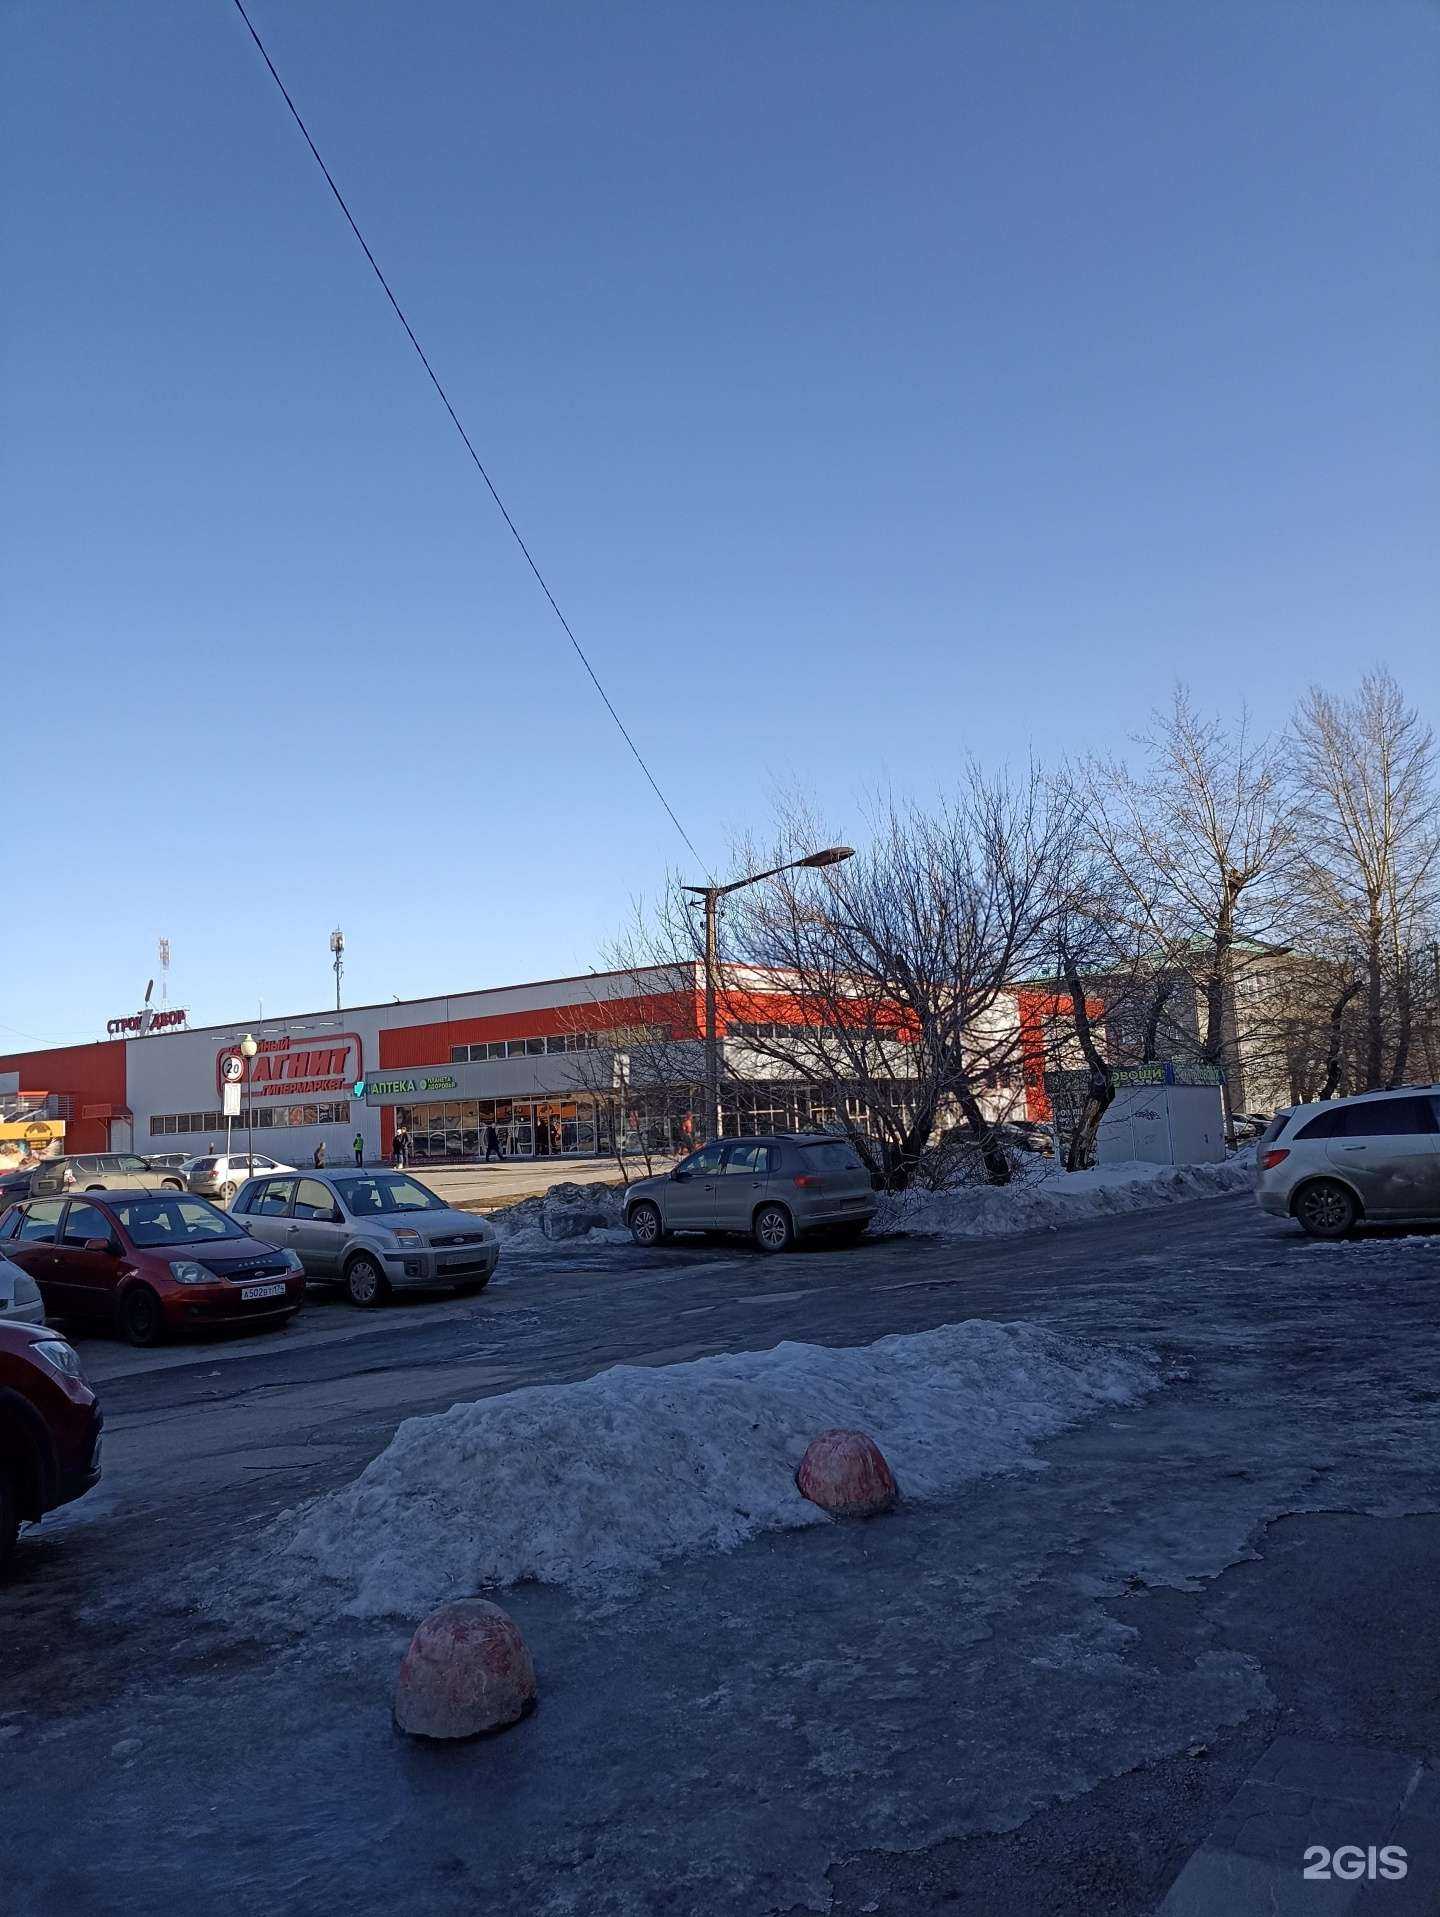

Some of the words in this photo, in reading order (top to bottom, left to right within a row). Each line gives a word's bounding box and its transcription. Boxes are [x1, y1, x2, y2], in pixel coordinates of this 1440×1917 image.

[150, 1010, 186, 1031] ДВОР
[225, 1047, 351, 1083] АГНИТ
[226, 1063, 240, 1074] 20
[263, 1078, 345, 1096] ГИПЕРМАРКЕТ
[372, 1081, 416, 1094] АПТЕКА
